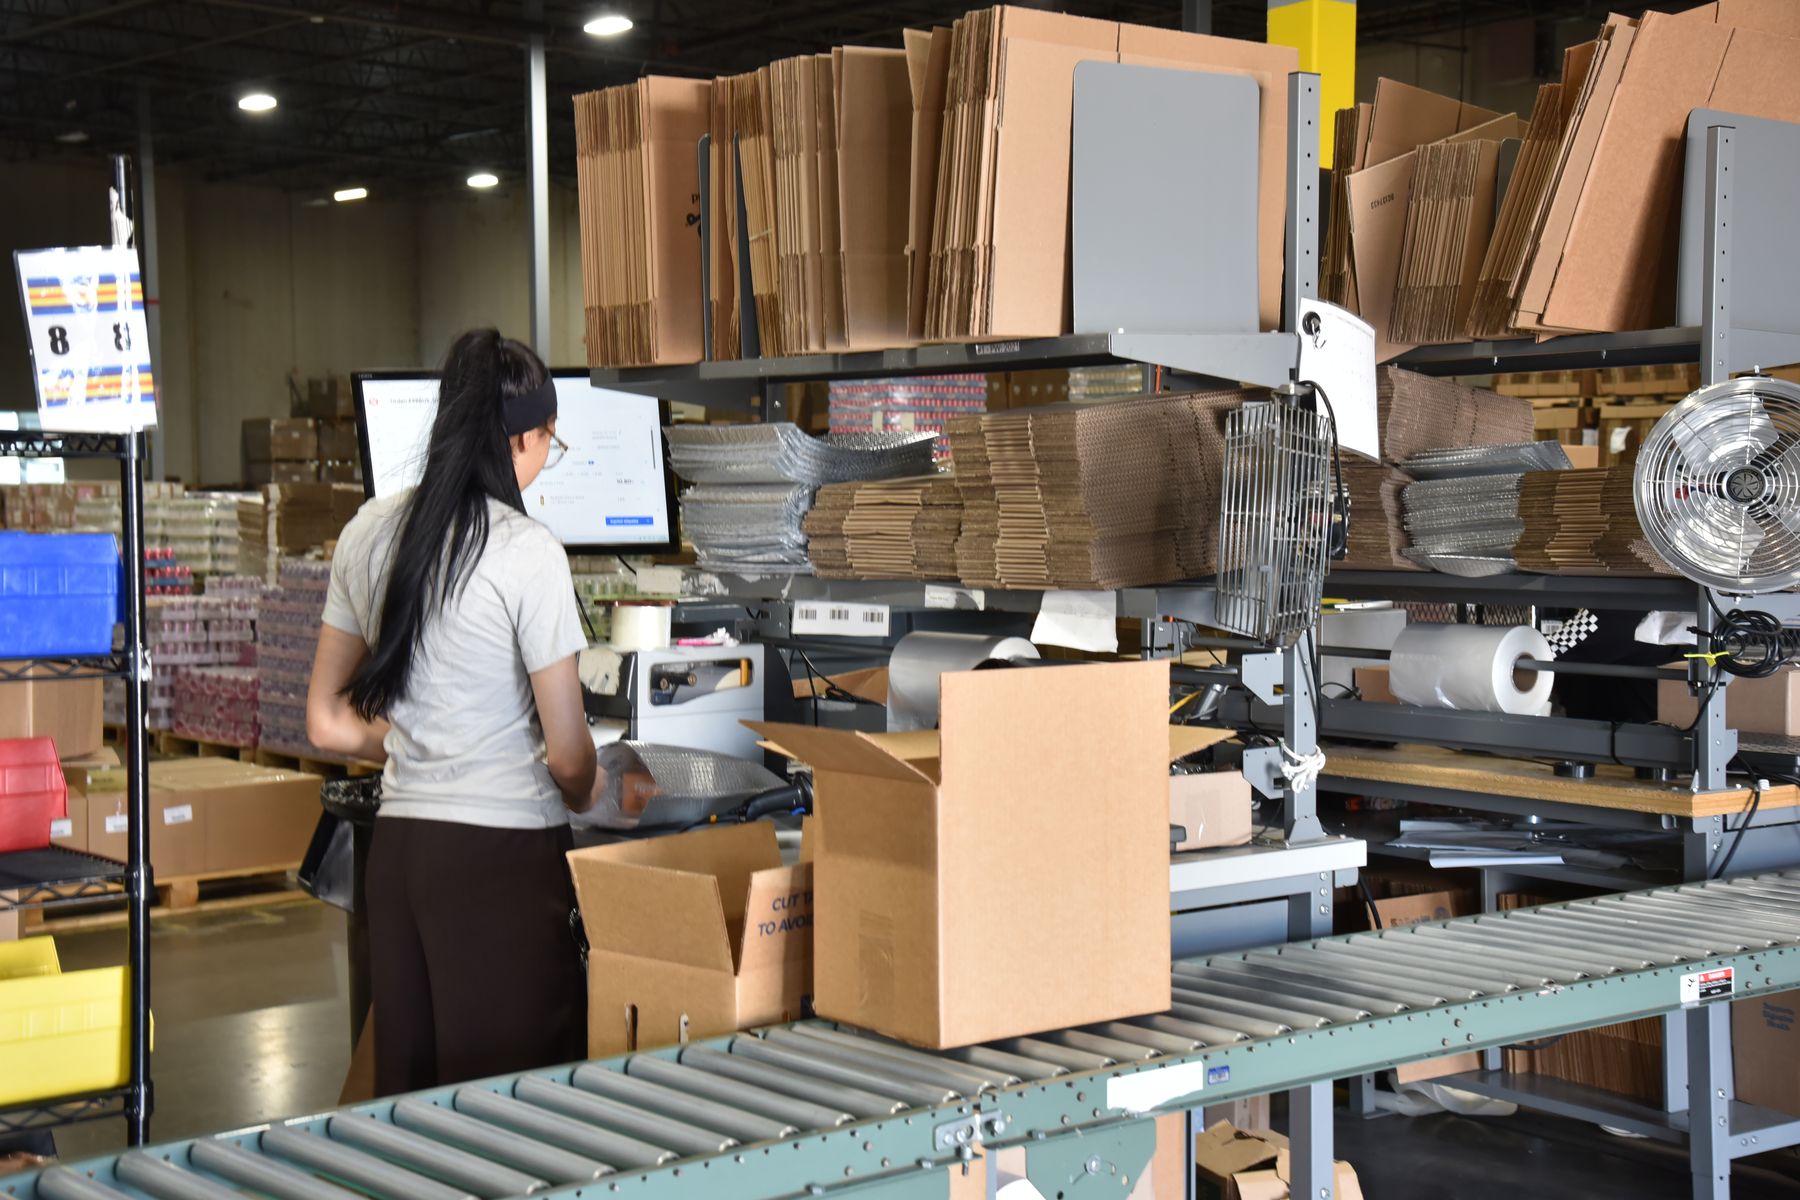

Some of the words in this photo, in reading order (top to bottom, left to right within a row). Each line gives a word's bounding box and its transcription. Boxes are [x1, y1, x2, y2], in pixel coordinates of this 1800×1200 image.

[48, 325, 70, 356] 8
[772, 894, 799, 912] CUT
[758, 921, 776, 936] TO
[778, 913, 813, 933] AVOI
